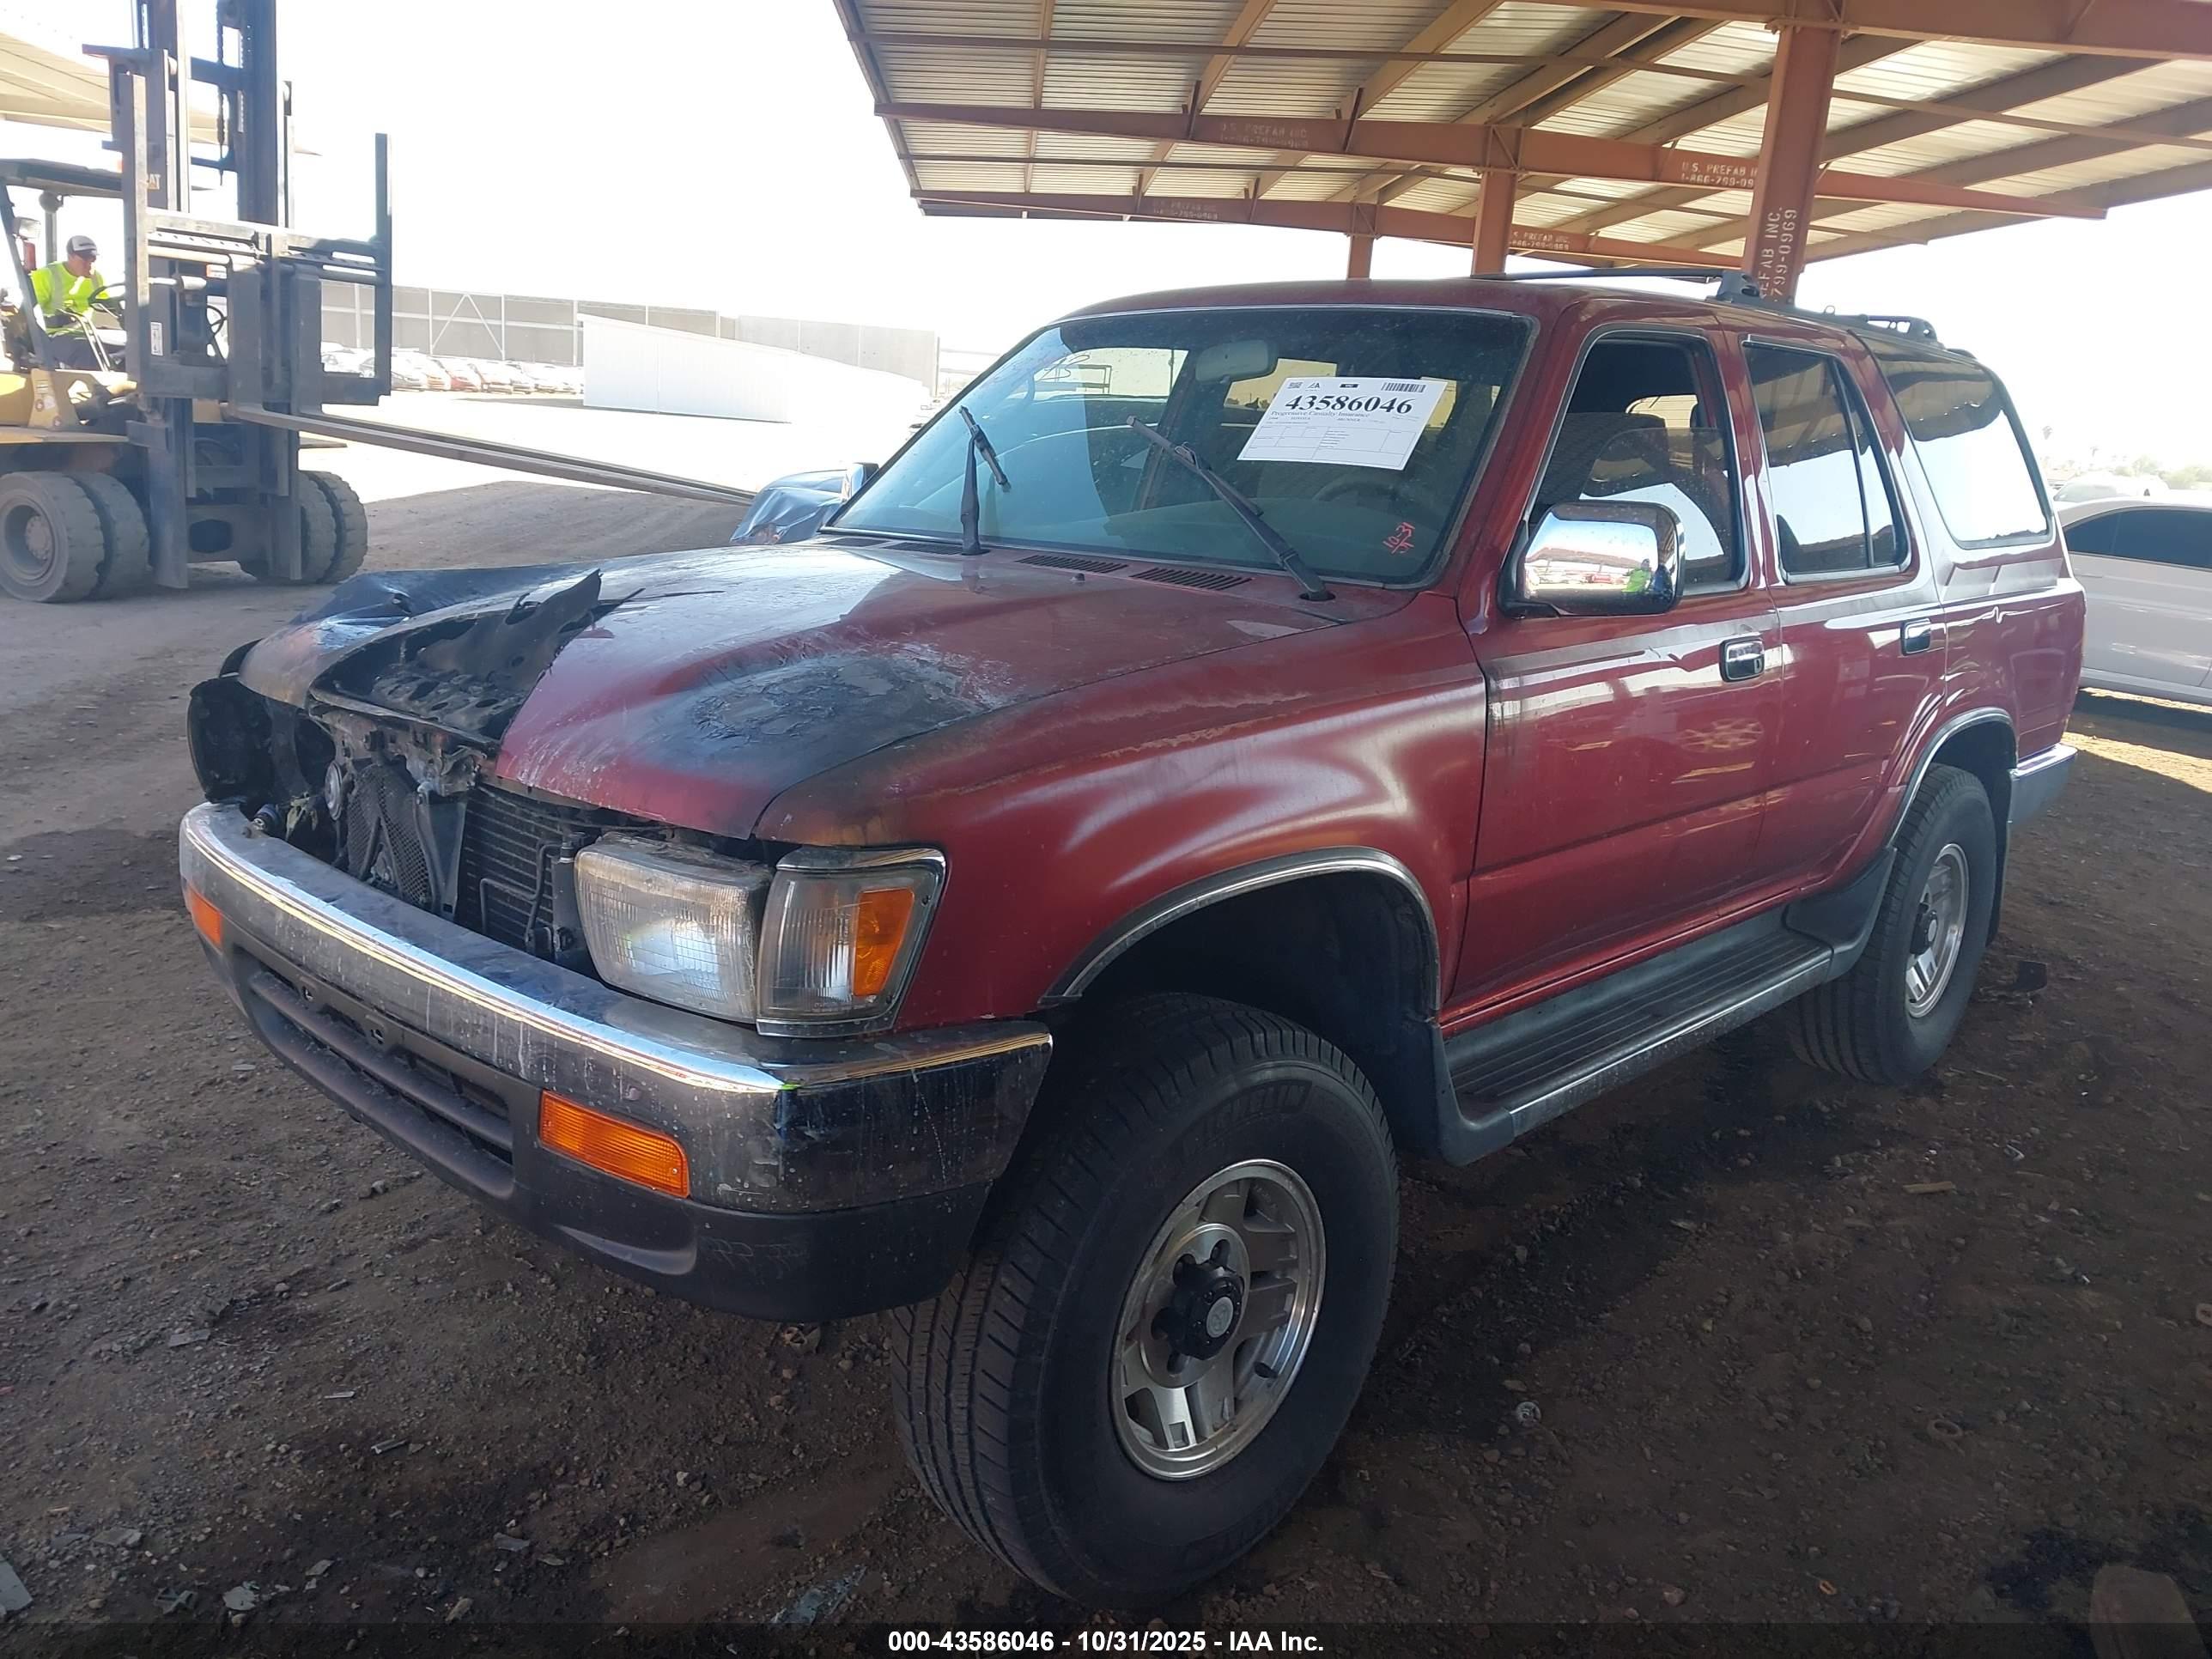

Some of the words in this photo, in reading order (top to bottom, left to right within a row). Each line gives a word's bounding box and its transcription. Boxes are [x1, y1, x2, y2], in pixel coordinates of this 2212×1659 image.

[1680, 173, 1755, 188] 1-866-799-09
[1765, 207, 1783, 239] INC.
[1285, 395, 1416, 415] 43586046
